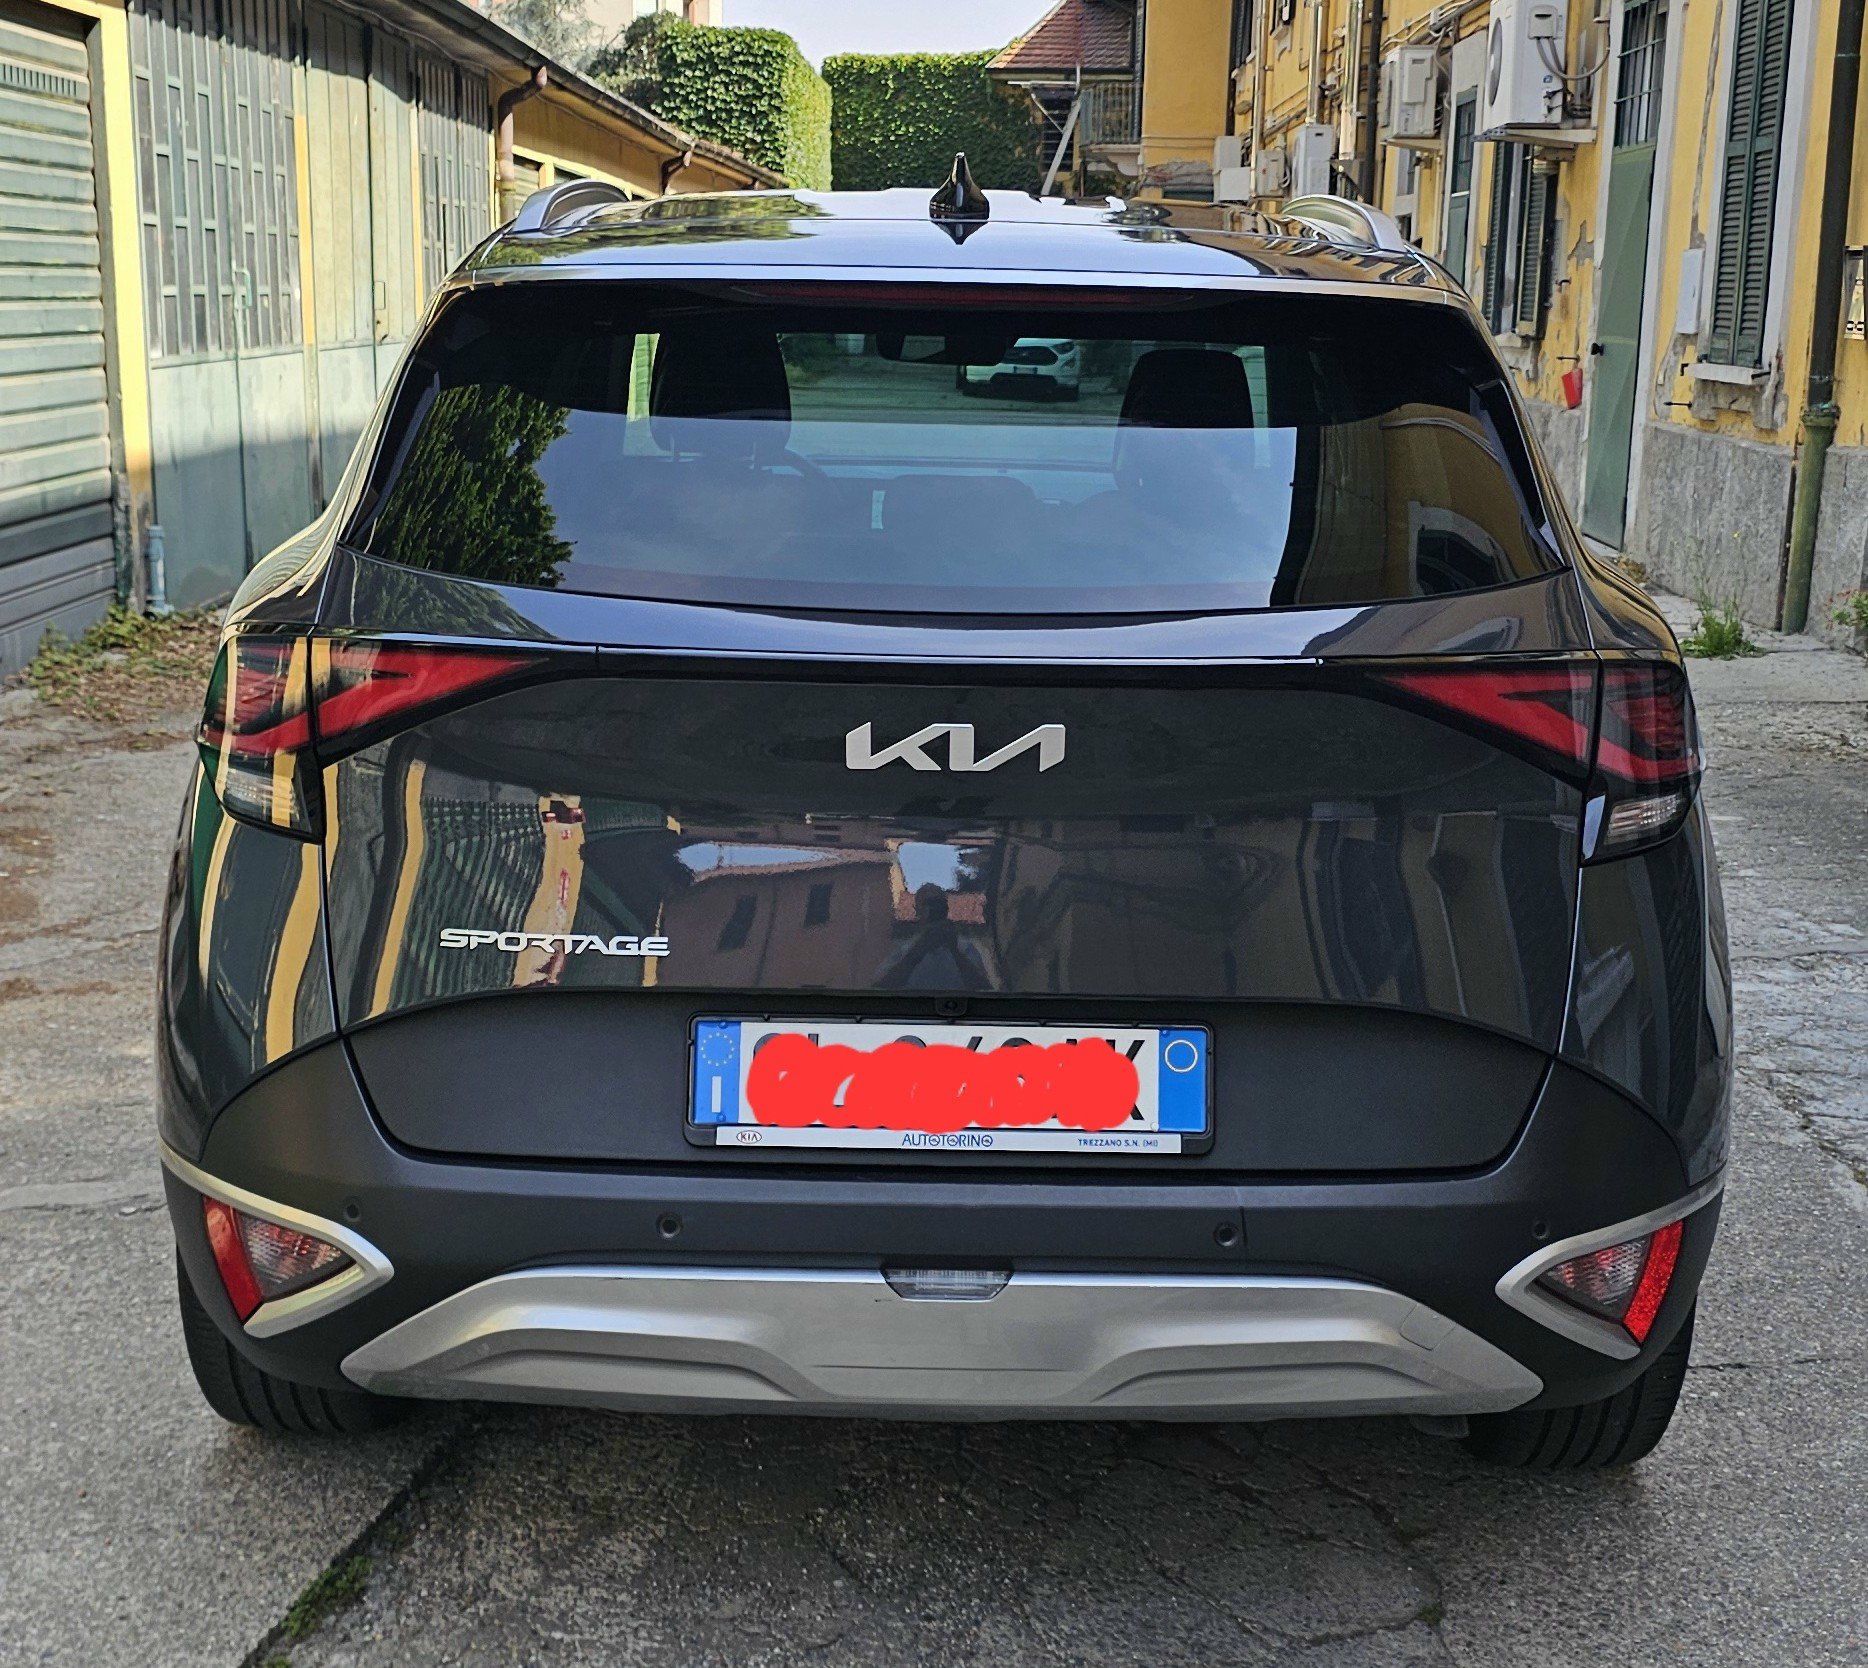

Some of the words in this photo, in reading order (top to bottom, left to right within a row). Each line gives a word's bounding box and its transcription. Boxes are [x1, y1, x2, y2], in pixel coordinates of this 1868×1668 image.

[846, 722, 1066, 772] KIA
[440, 928, 671, 957] SPORTAGE
[738, 1132, 760, 1142] KIA
[902, 1133, 993, 1147] AUTOTORINO
[1078, 1138, 1122, 1147] TREZZANO
